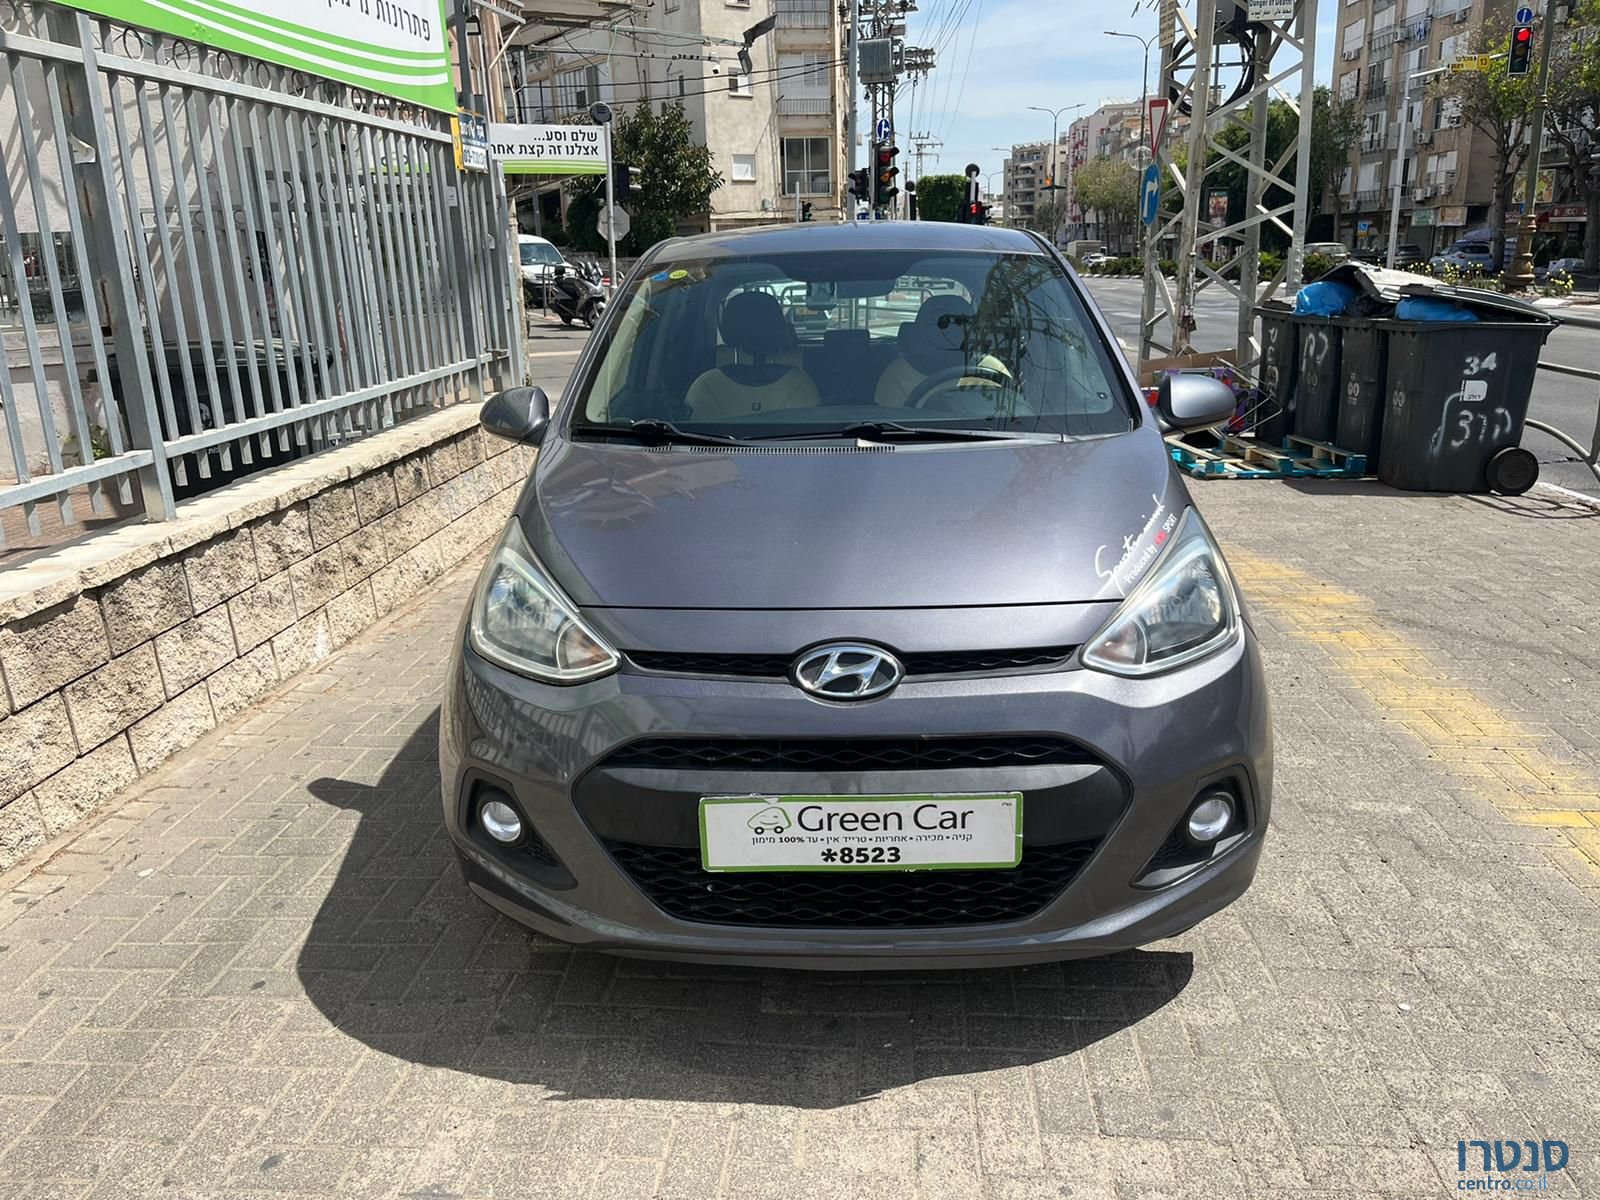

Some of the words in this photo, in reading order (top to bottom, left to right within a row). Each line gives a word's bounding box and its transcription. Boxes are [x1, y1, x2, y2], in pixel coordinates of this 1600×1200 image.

[376, 0, 430, 41] פתרונות
[534, 131, 567, 141] וסע...
[571, 130, 598, 142] שלם
[519, 144, 544, 158] קצת
[549, 144, 562, 155] זה
[566, 143, 599, 156] אצלנו
[1463, 352, 1497, 375] 34
[1124, 549, 1151, 584] Produced
[1146, 543, 1158, 555] by
[1162, 513, 1178, 533] SPORT
[797, 805, 903, 832] Green
[913, 804, 974, 830] Car
[752, 837, 776, 846] מימון
[779, 836, 805, 844] 100%
[826, 836, 840, 845] אין
[874, 835, 908, 843] אחריות
[915, 834, 944, 842] מכירה
[951, 833, 973, 842] קניה
